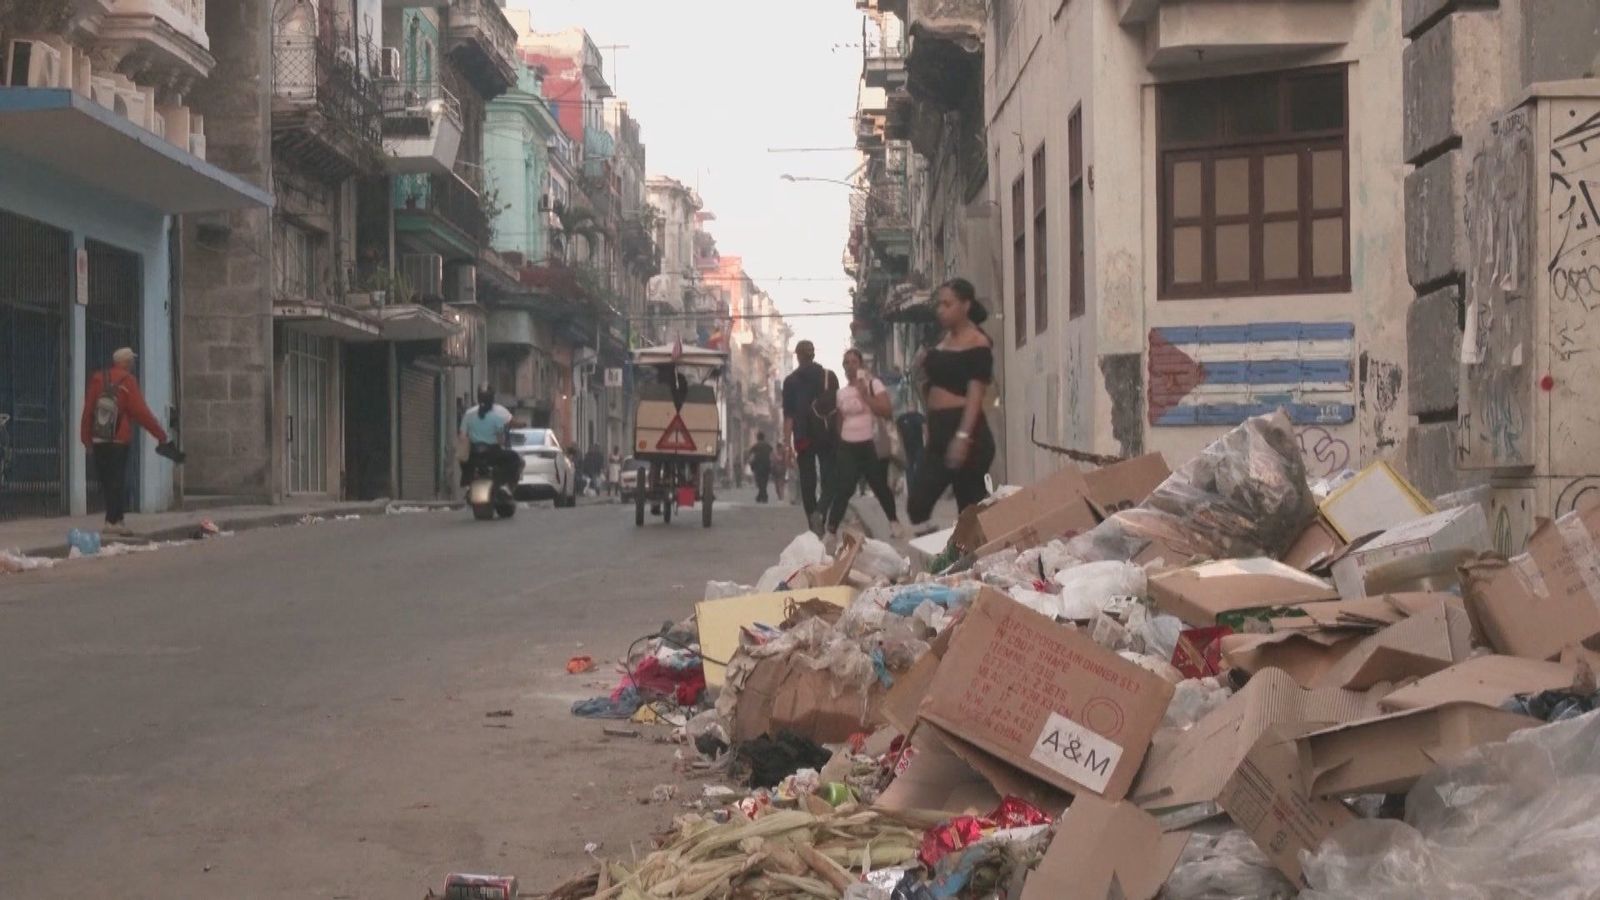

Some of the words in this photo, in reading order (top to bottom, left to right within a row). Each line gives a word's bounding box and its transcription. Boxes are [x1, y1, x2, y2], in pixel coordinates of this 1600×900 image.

[1036, 649, 1071, 674] SHAPE
[1081, 657, 1119, 684] DINNER
[1118, 676, 1141, 694] SET
[1041, 680, 1069, 701] SETS
[1041, 730, 1111, 777] A&M
